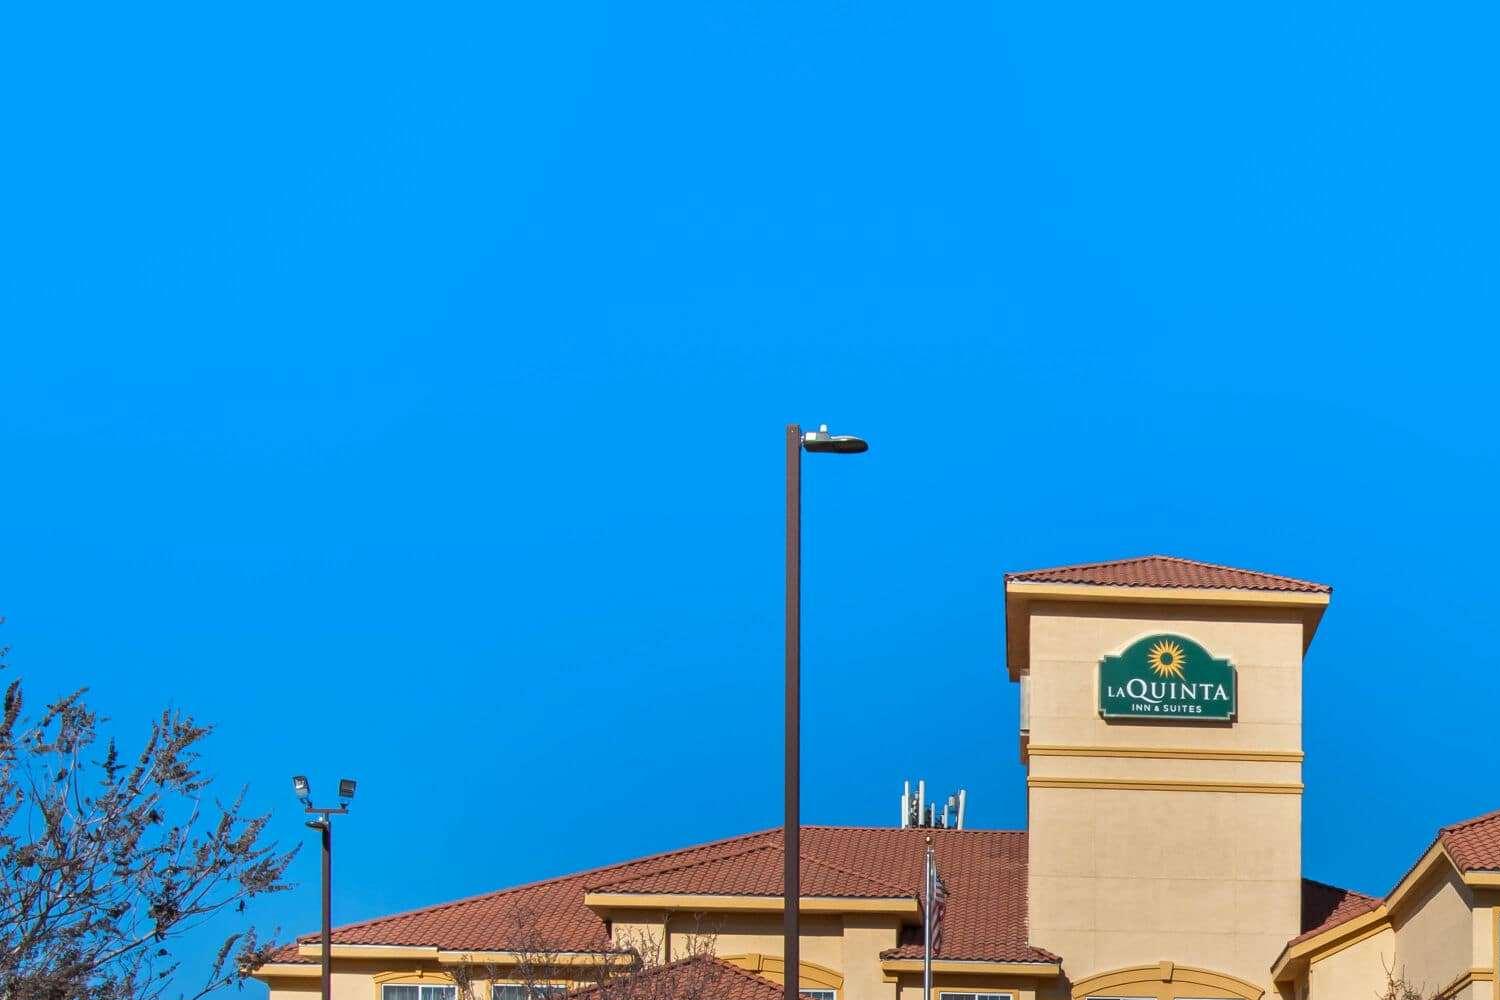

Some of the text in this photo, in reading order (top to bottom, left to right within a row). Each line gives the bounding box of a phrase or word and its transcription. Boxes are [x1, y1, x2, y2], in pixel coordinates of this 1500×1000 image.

[1108, 678, 1230, 704] LA QUINTA
[1132, 703, 1202, 713] INN & SUITES
